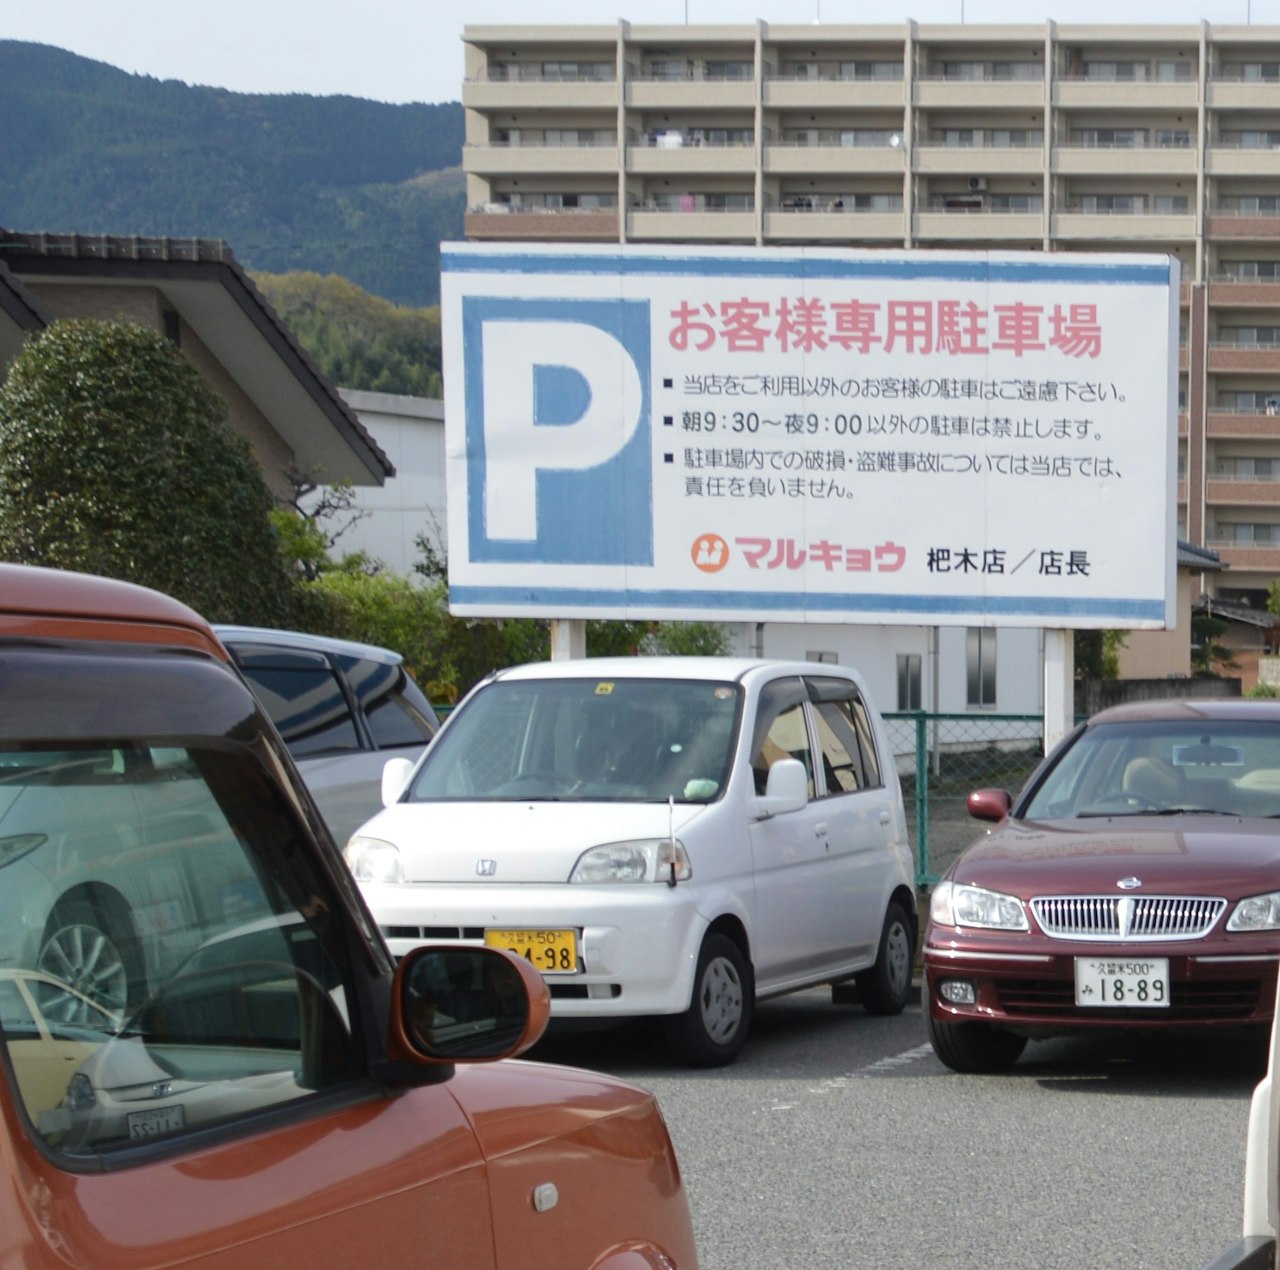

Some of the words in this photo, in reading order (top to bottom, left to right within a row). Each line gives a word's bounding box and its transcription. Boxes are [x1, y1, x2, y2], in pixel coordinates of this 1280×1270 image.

[668, 297, 1103, 359] お客様専用駐車場
[683, 374, 1126, 403] 当店をご利用以外のお客様の駐車はご遠慮下さい。
[482, 319, 643, 541] P
[684, 447, 1123, 479] 駐車場内での破損・盗難事故については当店では、
[684, 476, 853, 500] 責任を負いません。
[735, 536, 907, 573] マルキョウ
[1101, 978, 1165, 1002] 18-89
